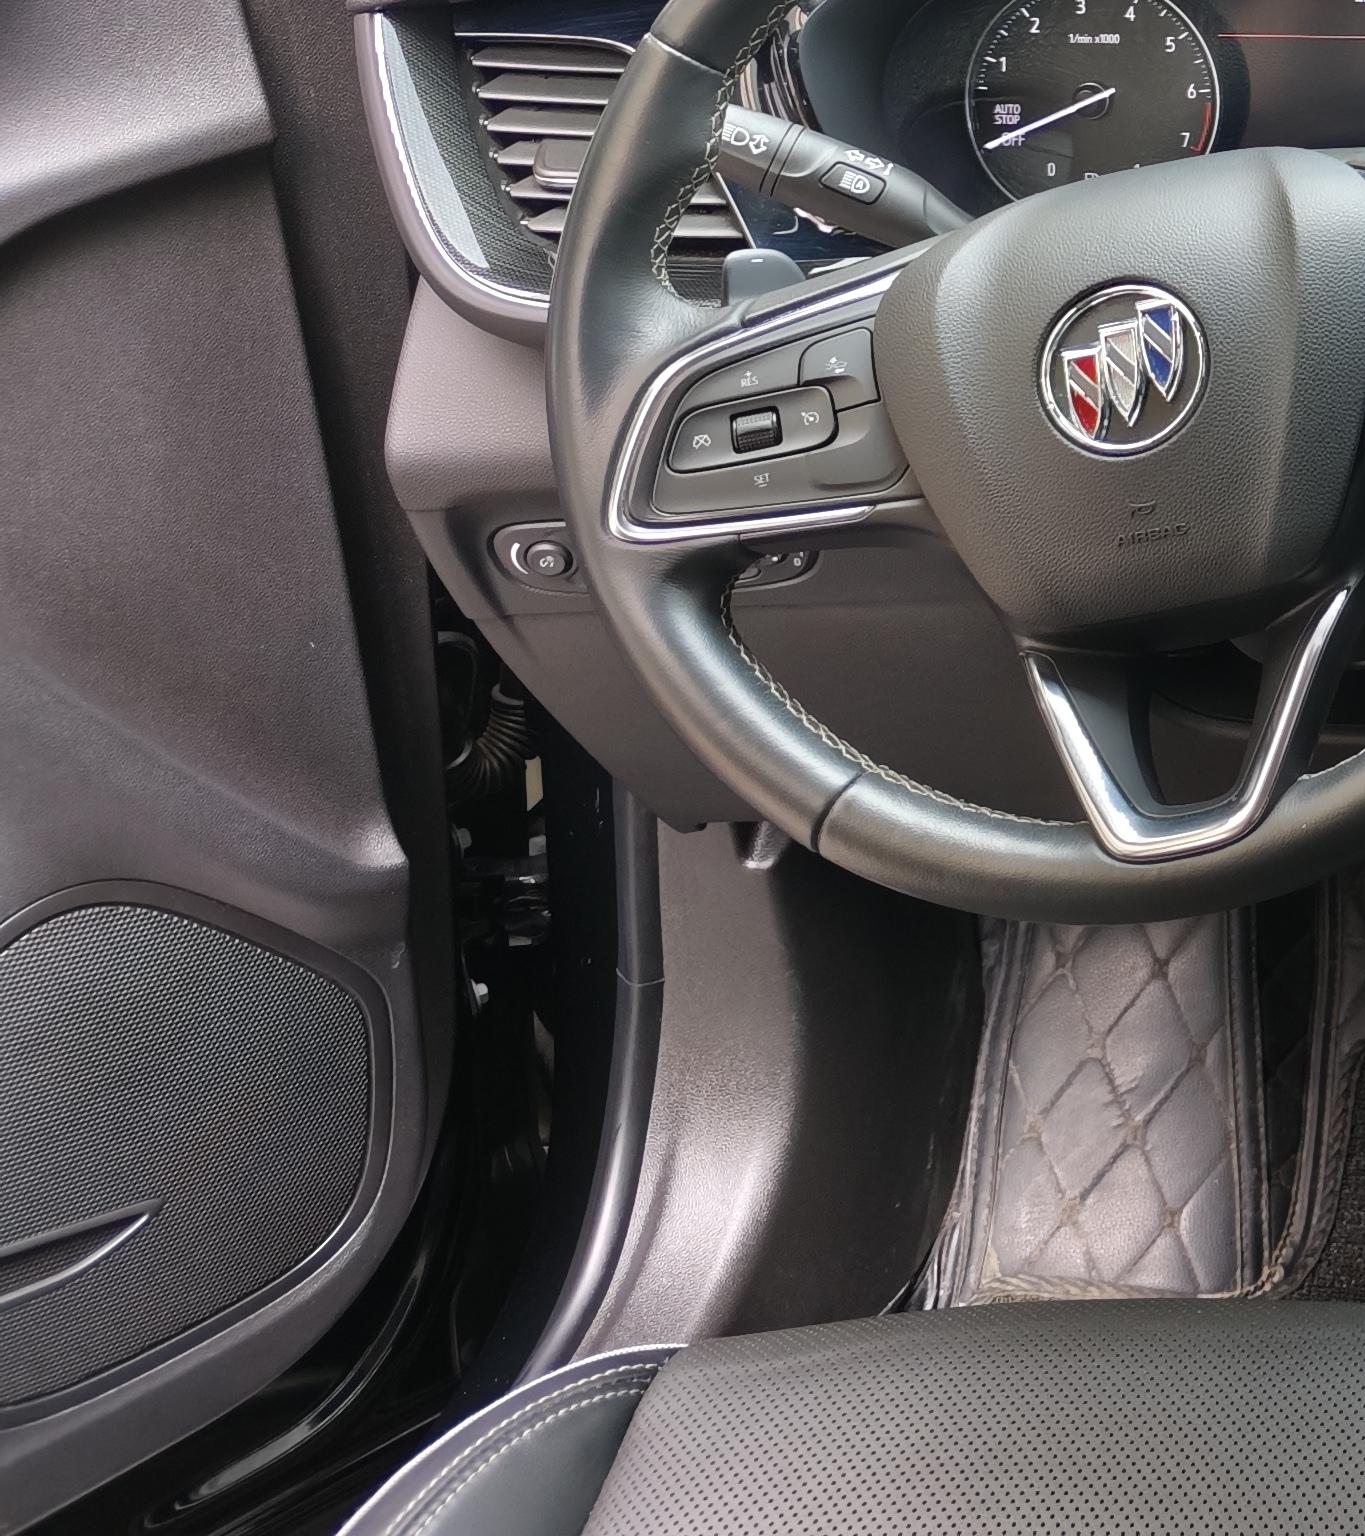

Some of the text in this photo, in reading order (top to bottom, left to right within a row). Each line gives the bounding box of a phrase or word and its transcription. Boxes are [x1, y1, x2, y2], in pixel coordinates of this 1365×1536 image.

[1075, 0, 1087, 14] 3
[1124, 5, 1136, 22] 4
[1029, 18, 1041, 34] 2
[1165, 37, 1176, 53] 5
[999, 56, 1008, 72] 1
[1187, 83, 1197, 99] 6
[993, 103, 1021, 115] AUTO
[994, 114, 1021, 125] STOP
[1001, 132, 1026, 147] OFF
[1179, 132, 1191, 148] 7
[1047, 162, 1056, 177] 0
[754, 472, 770, 484] SET
